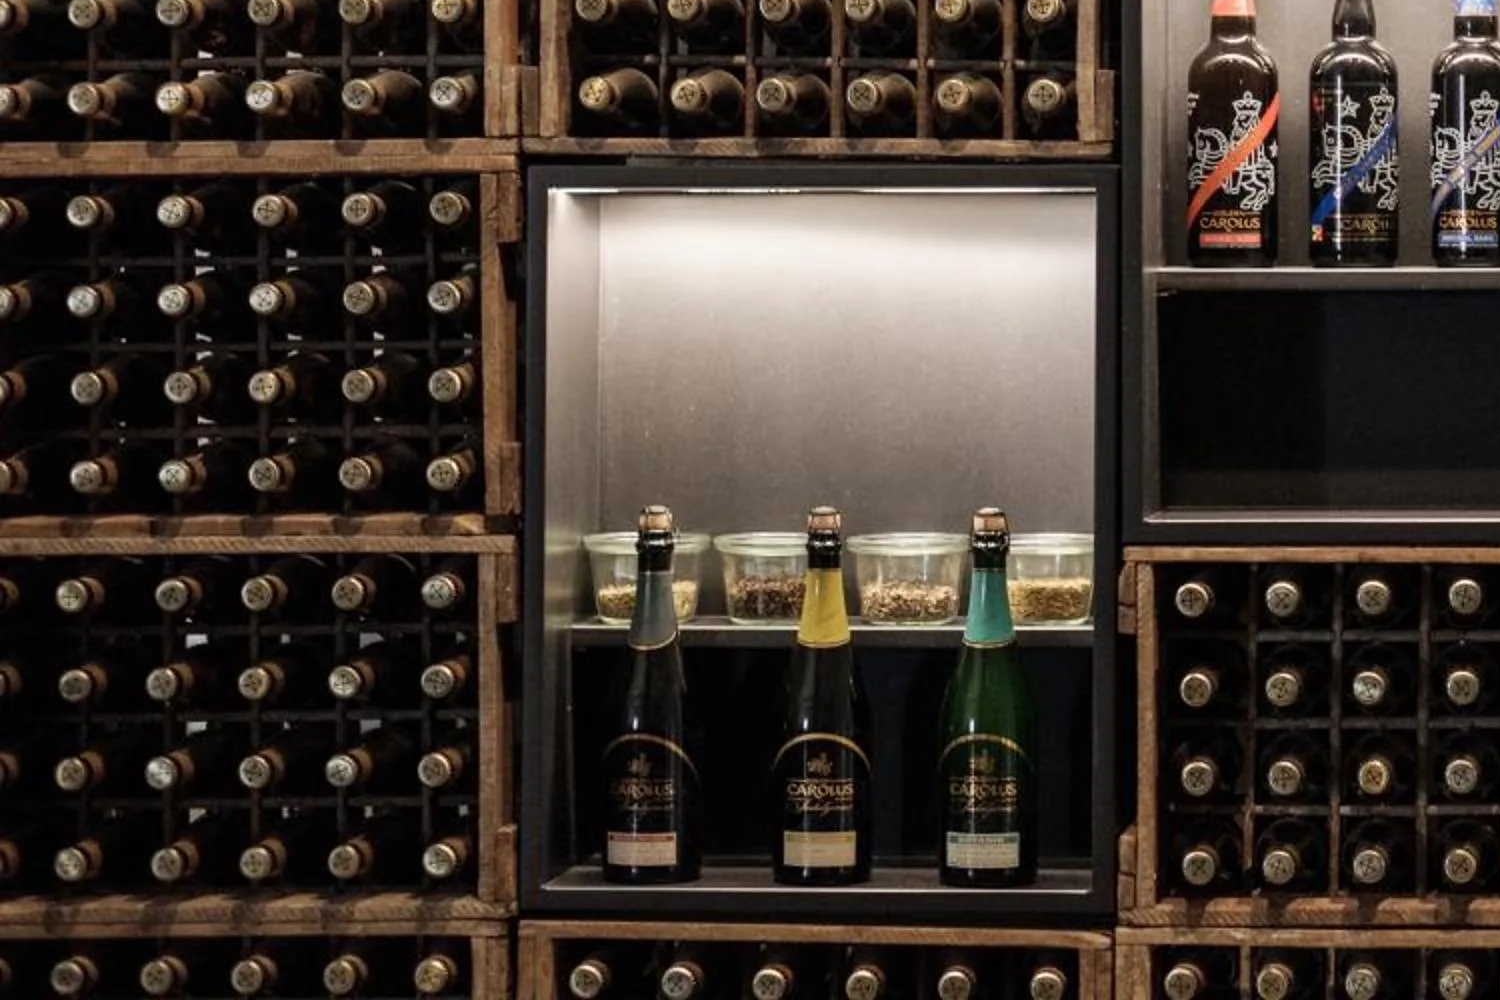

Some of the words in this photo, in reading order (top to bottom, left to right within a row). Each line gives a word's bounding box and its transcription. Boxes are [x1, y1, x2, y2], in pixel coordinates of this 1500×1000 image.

[1200, 218, 1260, 232] CAROLUS
[611, 782, 674, 799] AROLUS
[787, 783, 854, 798] CAROLUS
